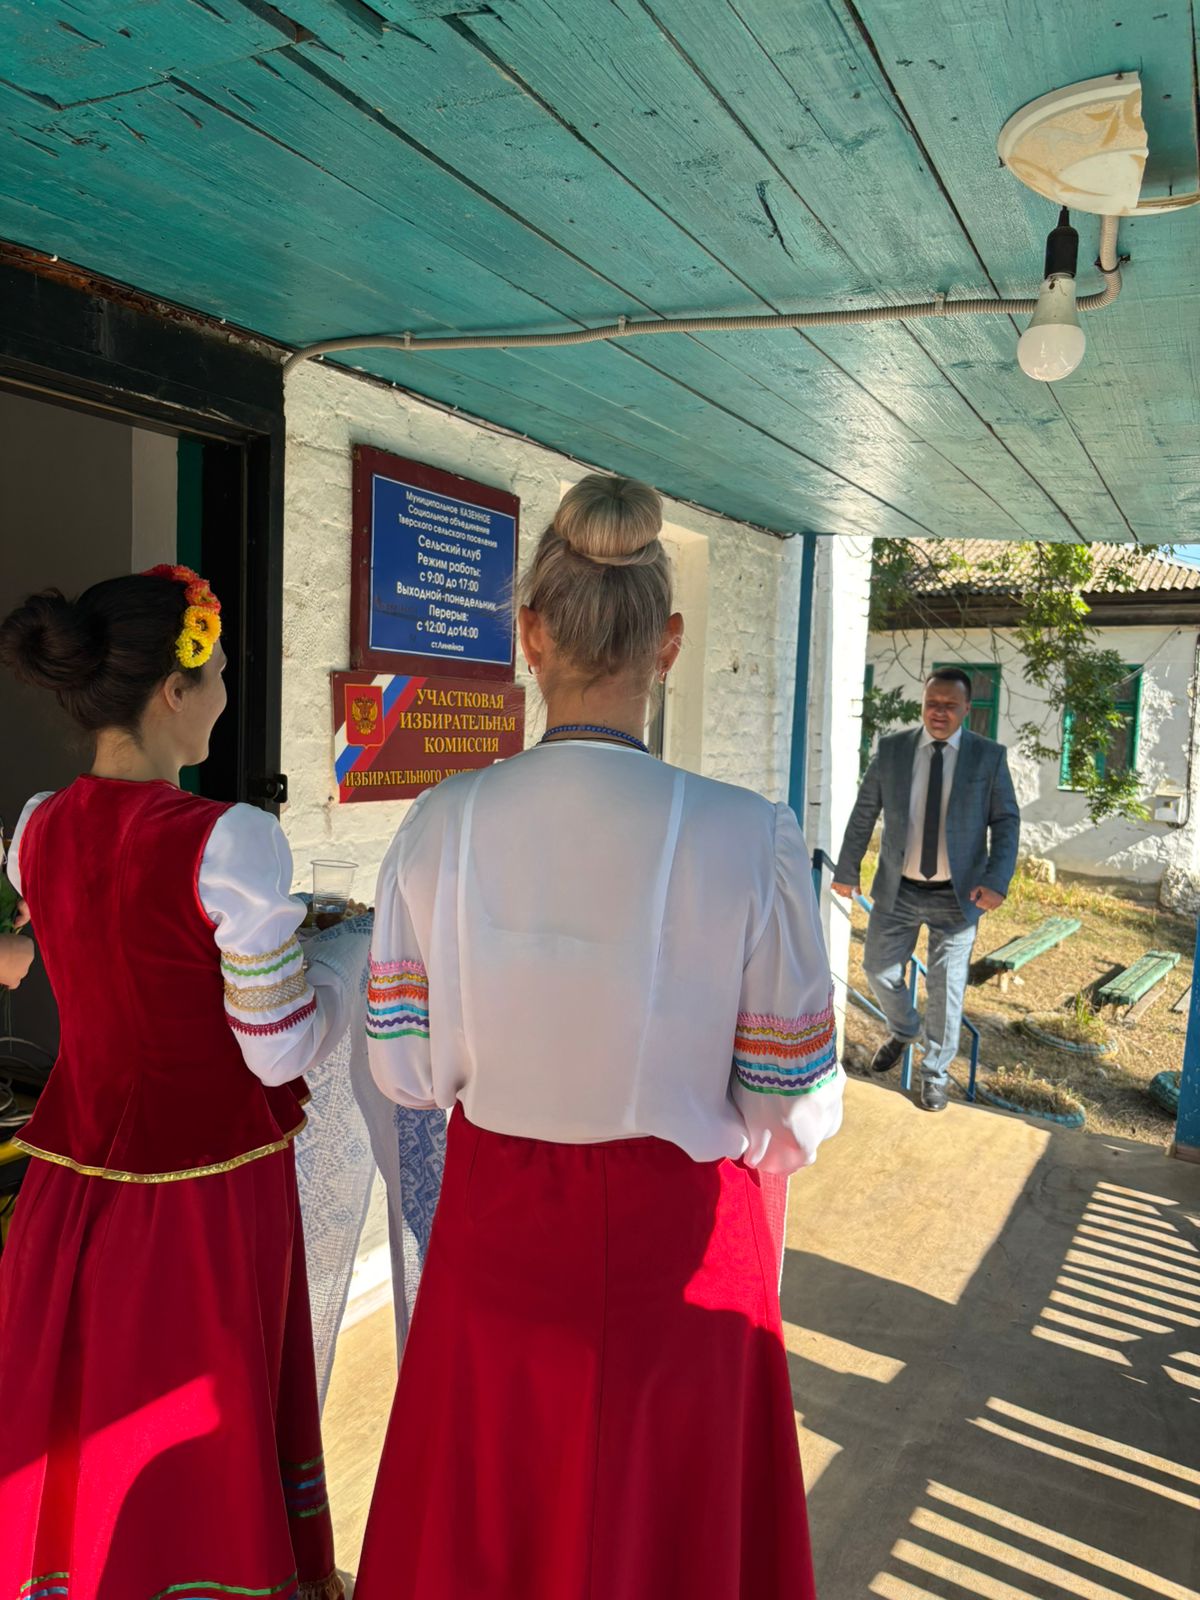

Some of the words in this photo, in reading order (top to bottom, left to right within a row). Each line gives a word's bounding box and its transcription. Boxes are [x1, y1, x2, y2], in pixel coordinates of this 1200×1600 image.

[406, 491, 458, 513] Муниципальное
[408, 504, 449, 524] Социальное
[398, 514, 433, 531] Тверского
[433, 525, 466, 540] сельского
[467, 535, 498, 548] поселения
[418, 534, 461, 555] Сельский
[462, 548, 481, 562] клуб
[417, 552, 447, 570] Режим
[449, 562, 481, 577] работы:
[419, 572, 426, 582] с
[427, 571, 445, 585] 9:00
[445, 579, 457, 589] до
[458, 578, 479, 592] 17:00
[429, 604, 469, 622] Перерыв:
[416, 621, 423, 631] с
[424, 620, 446, 634] 12:00
[416, 688, 504, 709] УЧАСТКОВАЯ
[400, 712, 516, 731] ИЗБИРАТЕЛЬНАЯ
[424, 737, 500, 753] КОМИССИЯ
[345, 769, 442, 787] ИЗБИРАТЕЛЬНОГО
